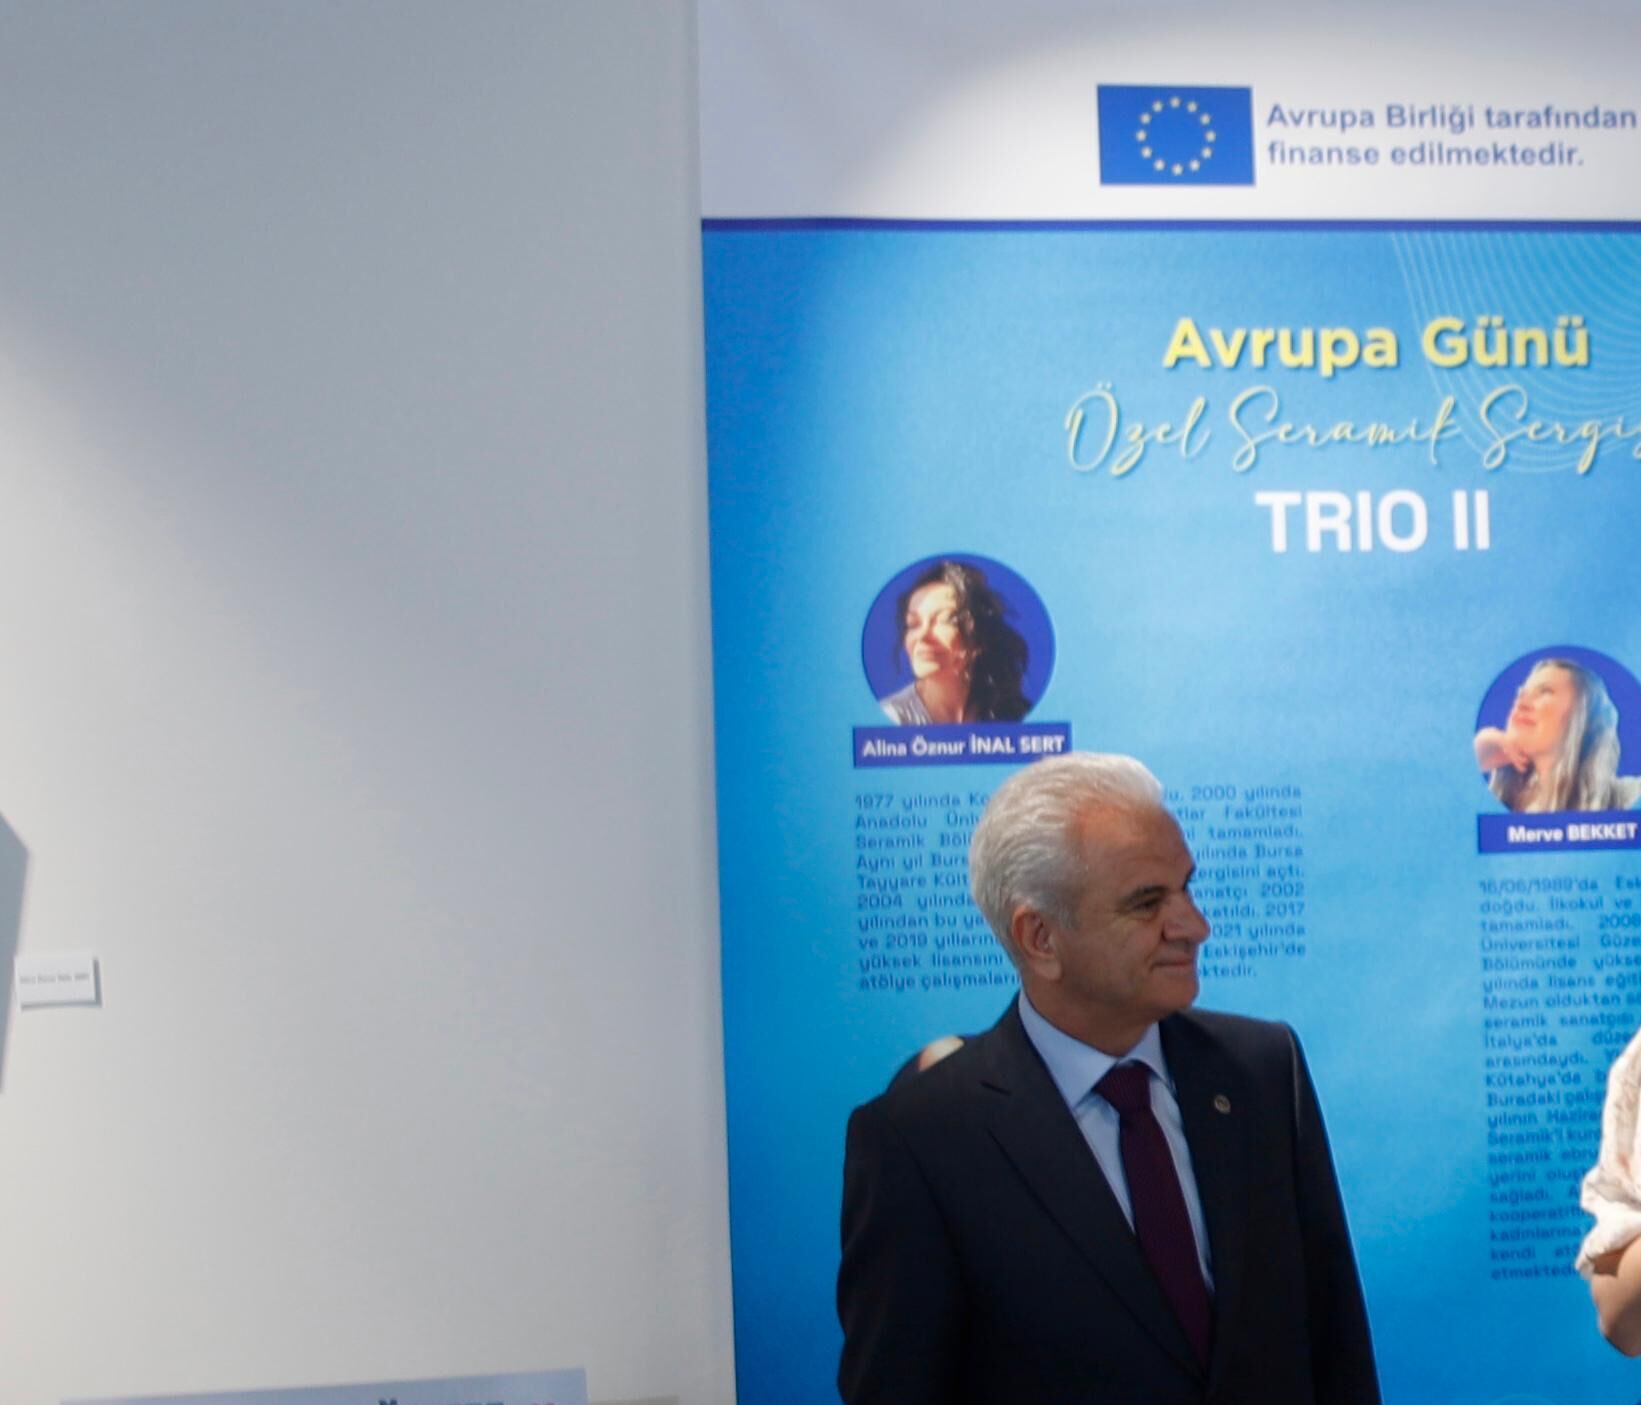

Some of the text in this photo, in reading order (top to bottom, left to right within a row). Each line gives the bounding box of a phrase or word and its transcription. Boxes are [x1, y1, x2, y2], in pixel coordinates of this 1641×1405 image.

[1267, 104, 1638, 133] Avrupa Birliği tarafından
[1267, 141, 1584, 167] finanse edilmektedir.
[1162, 316, 1590, 377] Avrupa Günü
[1064, 382, 1210, 477] Özel
[1229, 384, 1461, 472] Seramik
[1254, 489, 1491, 554] TRIO II
[862, 733, 1065, 757] Alina Öznur İNAL SERT
[855, 813, 927, 830] Anadolu
[1177, 808, 1206, 821] tlar
[856, 832, 926, 850] Seramik
[1507, 822, 1638, 843] Merve BEKKET
[930, 850, 970, 868] Burs
[933, 871, 968, 888] Kült
[1198, 864, 1260, 882] ergisini
[1193, 885, 1248, 901] anatçı
[935, 911, 957, 929] bu
[1212, 922, 1242, 938] 021
